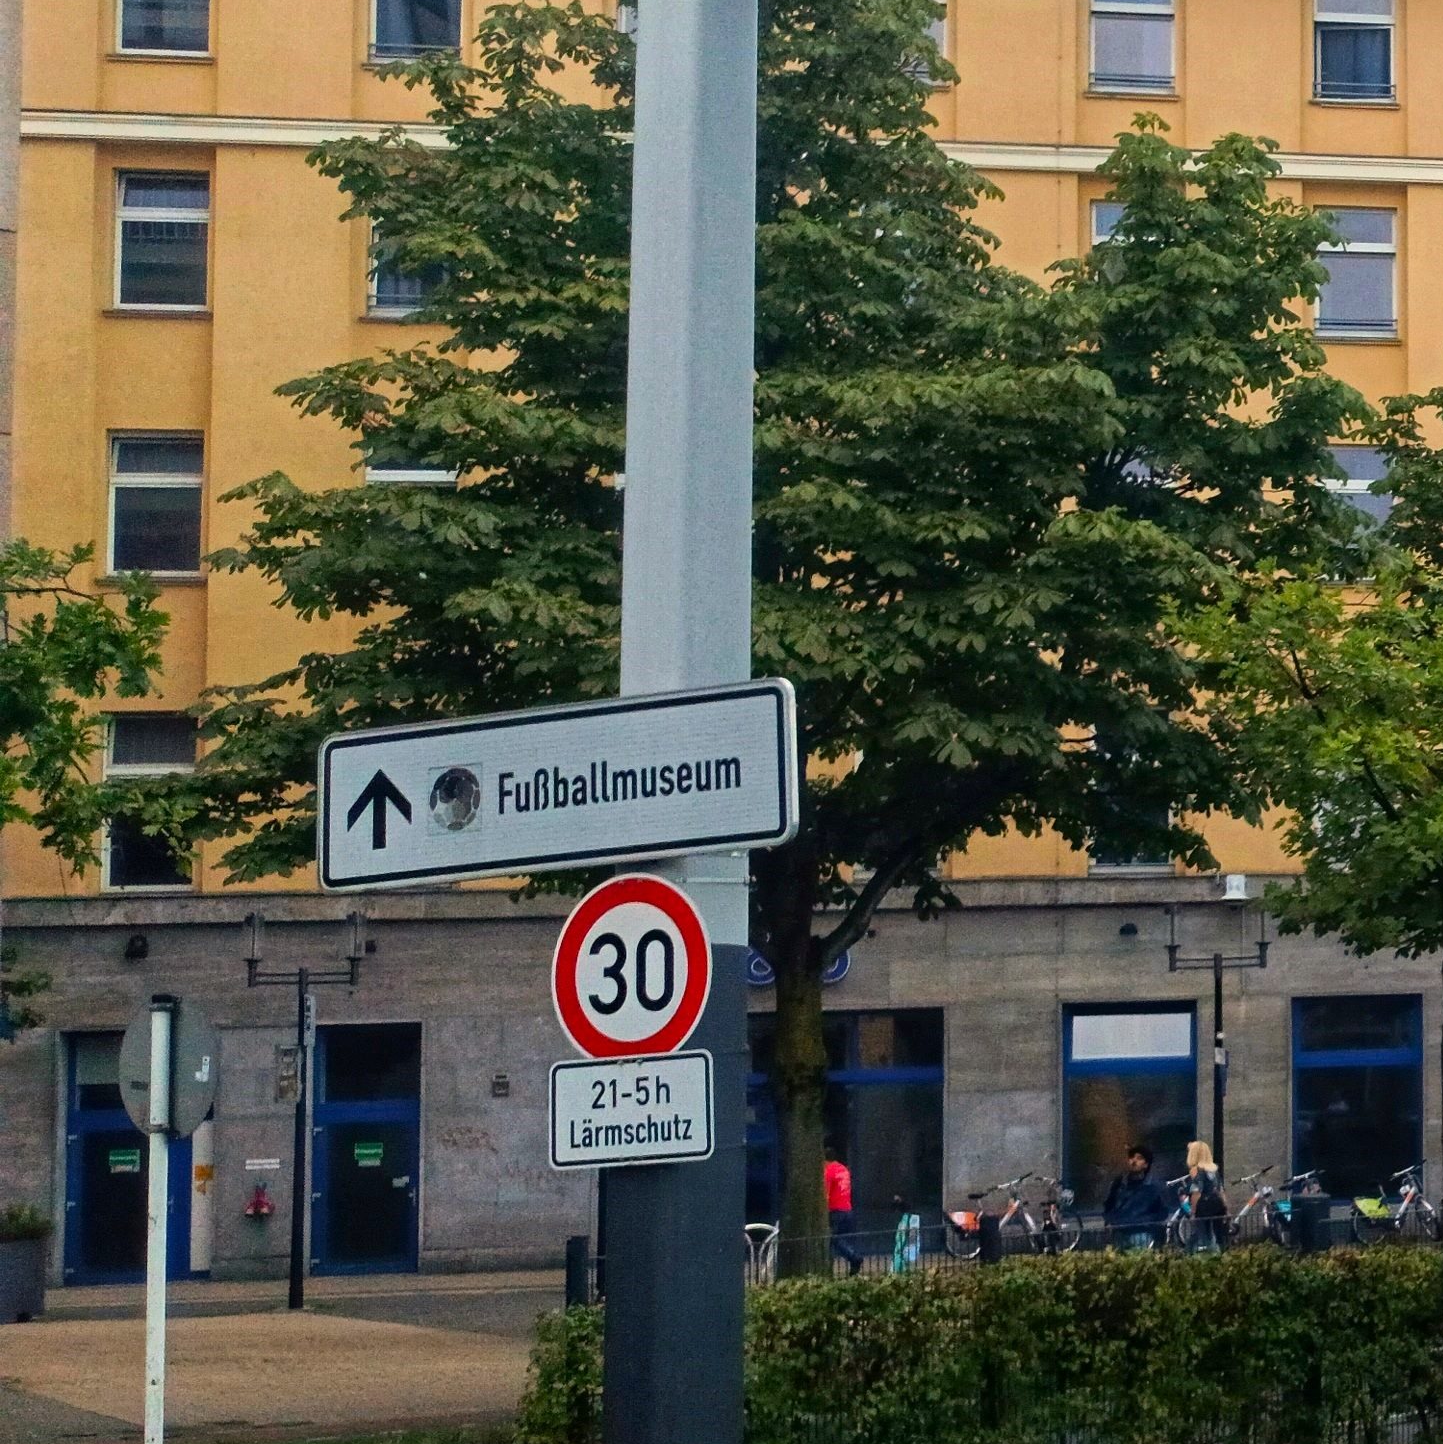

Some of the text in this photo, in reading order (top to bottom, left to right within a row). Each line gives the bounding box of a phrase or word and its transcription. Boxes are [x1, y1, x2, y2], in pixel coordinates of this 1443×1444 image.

[497, 755, 742, 816] Fußballmuseum
[587, 928, 675, 1016] 30
[591, 1074, 672, 1111] 21-5 h
[569, 1114, 693, 1150] Lärmschutz
